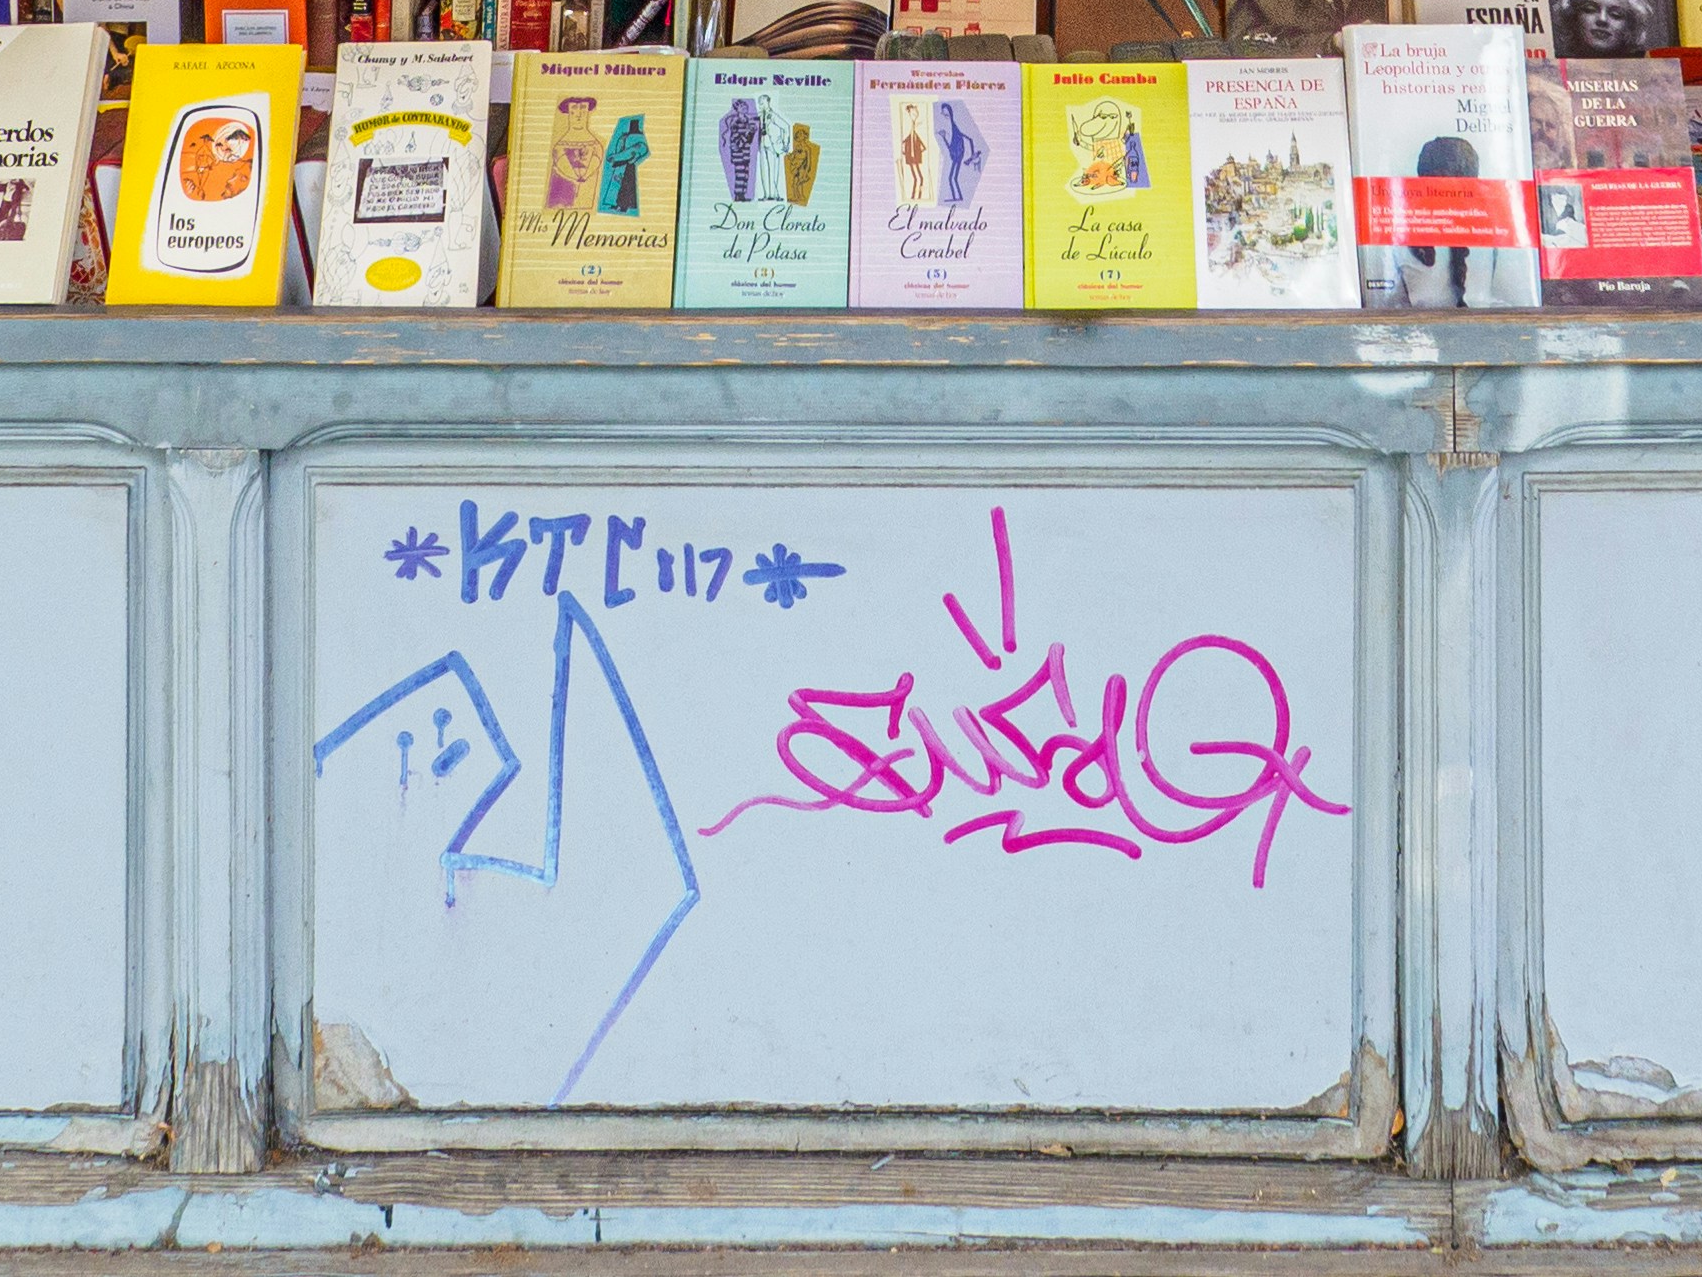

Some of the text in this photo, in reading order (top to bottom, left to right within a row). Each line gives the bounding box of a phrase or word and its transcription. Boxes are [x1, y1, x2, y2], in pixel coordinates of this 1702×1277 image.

[1380, 42, 1447, 61] La bruja
[173, 61, 256, 71] RAFAEL AZCONA
[1053, 72, 1158, 86] Julio Camba
[1206, 78, 1325, 94] PRESENCIA DE
[1566, 78, 1639, 93] MISERIAS
[1233, 94, 1298, 110] ESPAÑA
[1581, 97, 1626, 110] DE LA
[1574, 112, 1638, 128] GUERRA
[169, 213, 195, 232] los
[709, 202, 826, 233] Don Clorato
[1067, 206, 1143, 233] La casa
[167, 234, 245, 253] europeos
[900, 232, 971, 260] Carabel
